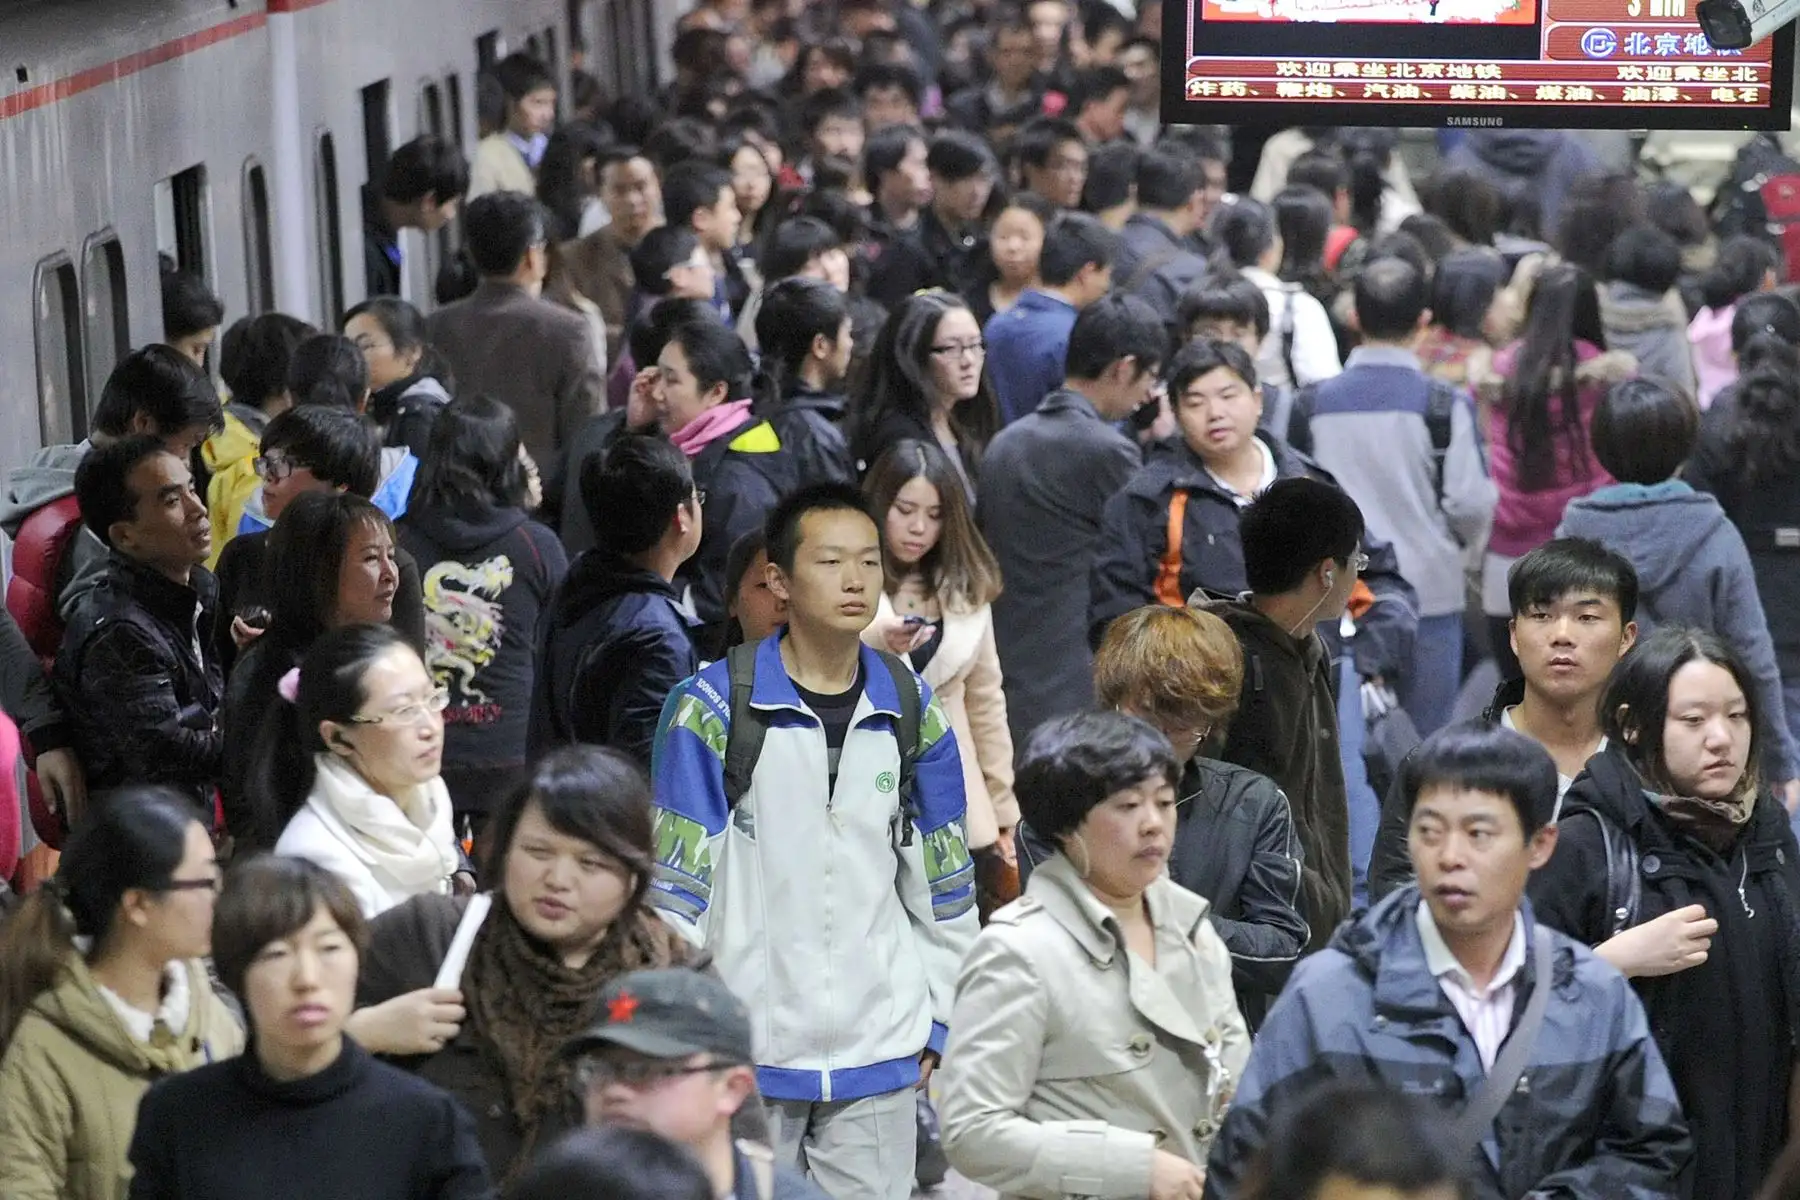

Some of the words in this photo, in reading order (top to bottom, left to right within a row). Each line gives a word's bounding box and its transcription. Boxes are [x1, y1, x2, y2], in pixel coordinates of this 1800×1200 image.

[1624, 32, 1743, 56] 北京地
[1276, 62, 1502, 80] 欢迎乘坐北京地铁
[1617, 65, 1758, 82] 欢迎乘坐北
[1447, 116, 1503, 126] SAMSUNG
[696, 678, 721, 704] SCHOOL
